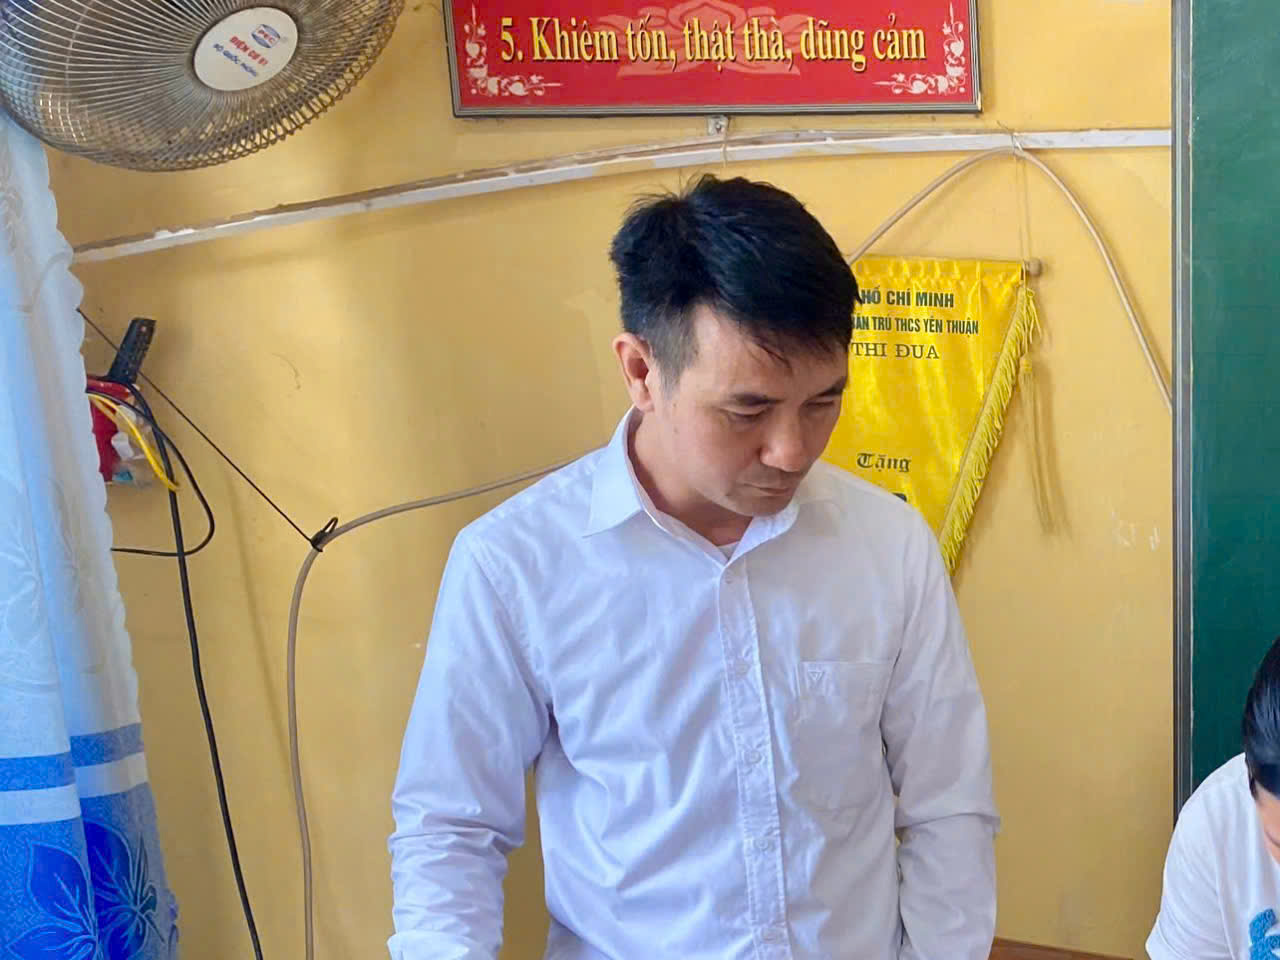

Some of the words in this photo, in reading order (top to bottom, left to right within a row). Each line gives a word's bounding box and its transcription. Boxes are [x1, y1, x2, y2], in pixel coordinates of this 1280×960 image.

[501, 17, 525, 62] 5.
[529, 16, 619, 62] Khiêm
[625, 13, 678, 72] tốn,
[682, 17, 737, 72] thật
[743, 16, 793, 70] thà,
[800, 16, 867, 72] dũng
[873, 12, 926, 60] cảm
[886, 288, 911, 306] CHÍ
[916, 291, 954, 308] MINH
[894, 318, 920, 333] THCS
[923, 315, 943, 333] YÊN
[947, 317, 979, 338] THUẬN
[852, 343, 887, 357] THI
[895, 344, 939, 359] ĐUA
